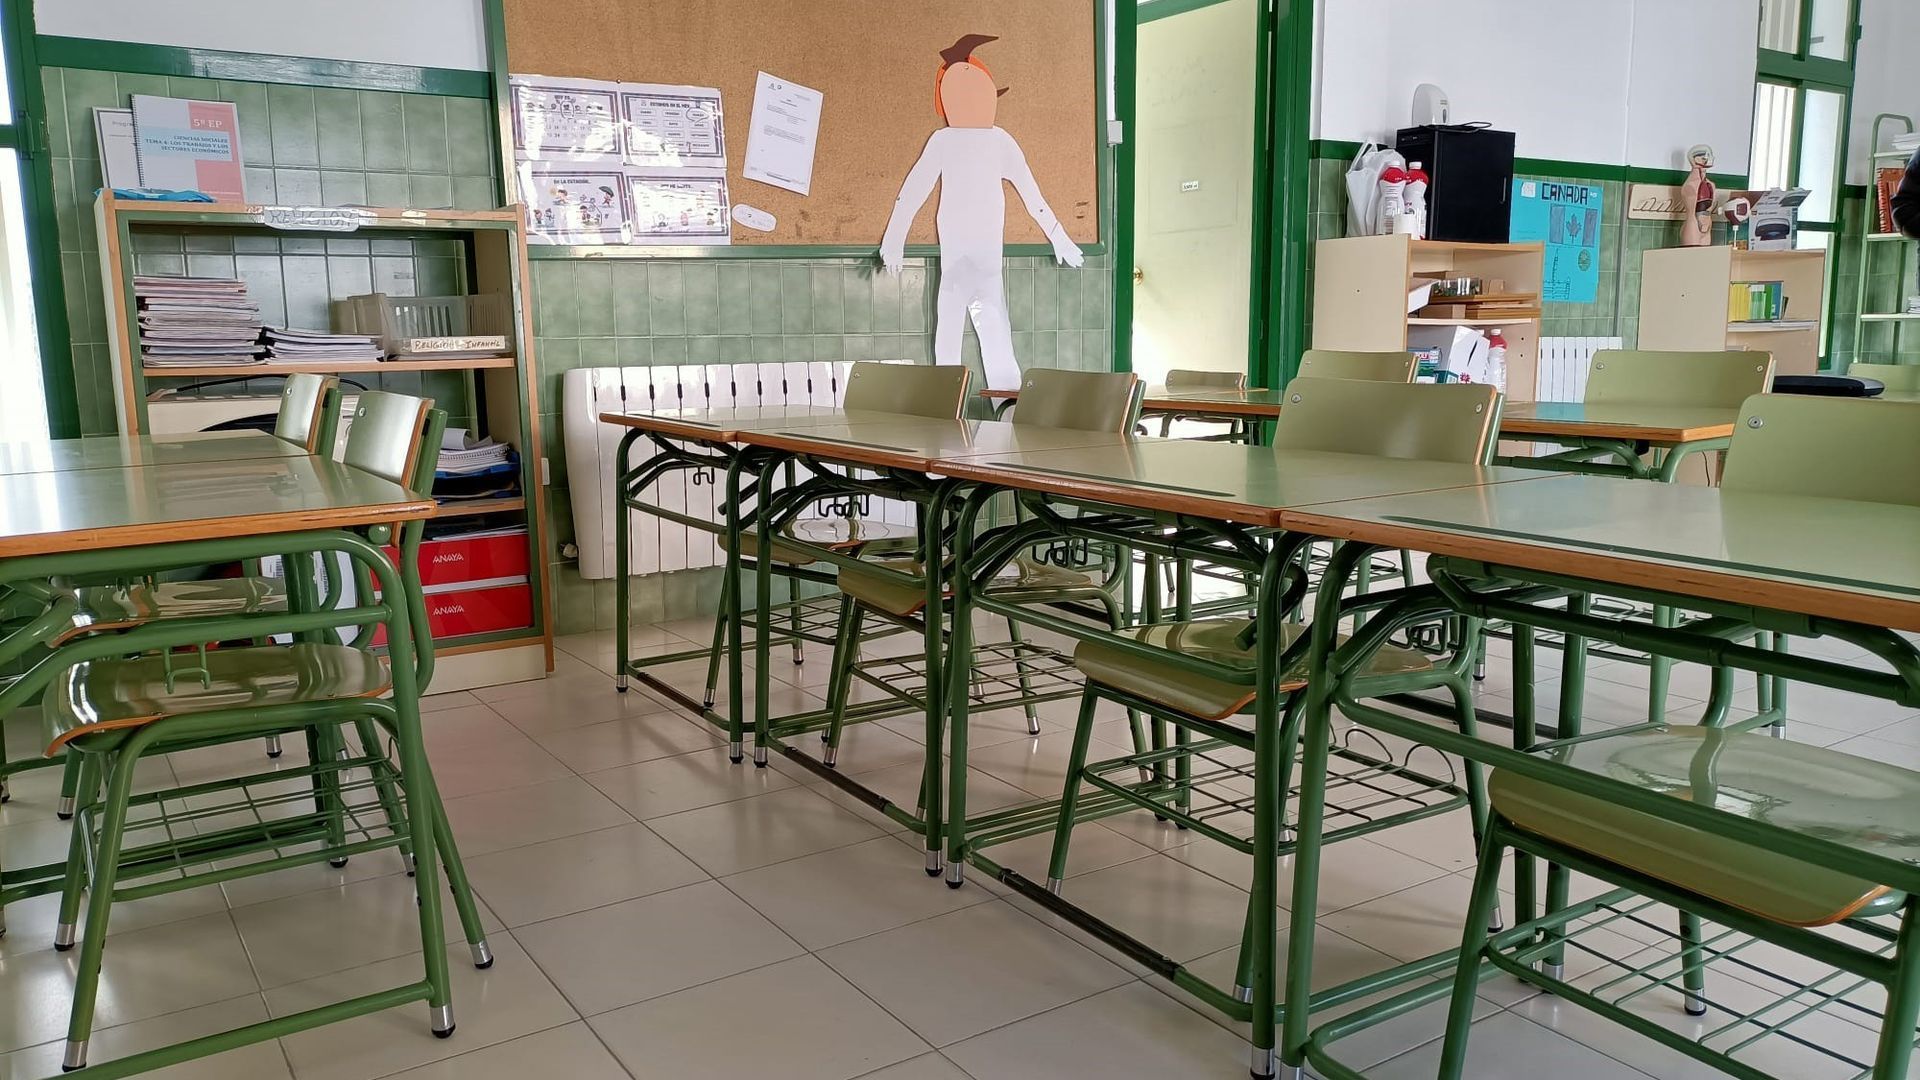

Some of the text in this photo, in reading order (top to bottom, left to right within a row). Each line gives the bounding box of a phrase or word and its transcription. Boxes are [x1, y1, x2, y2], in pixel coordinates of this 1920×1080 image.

[208, 120, 222, 128] EP
[1541, 183, 1588, 205] CANADA
[432, 553, 464, 564] ANAYA
[433, 605, 464, 616] ANAYA
